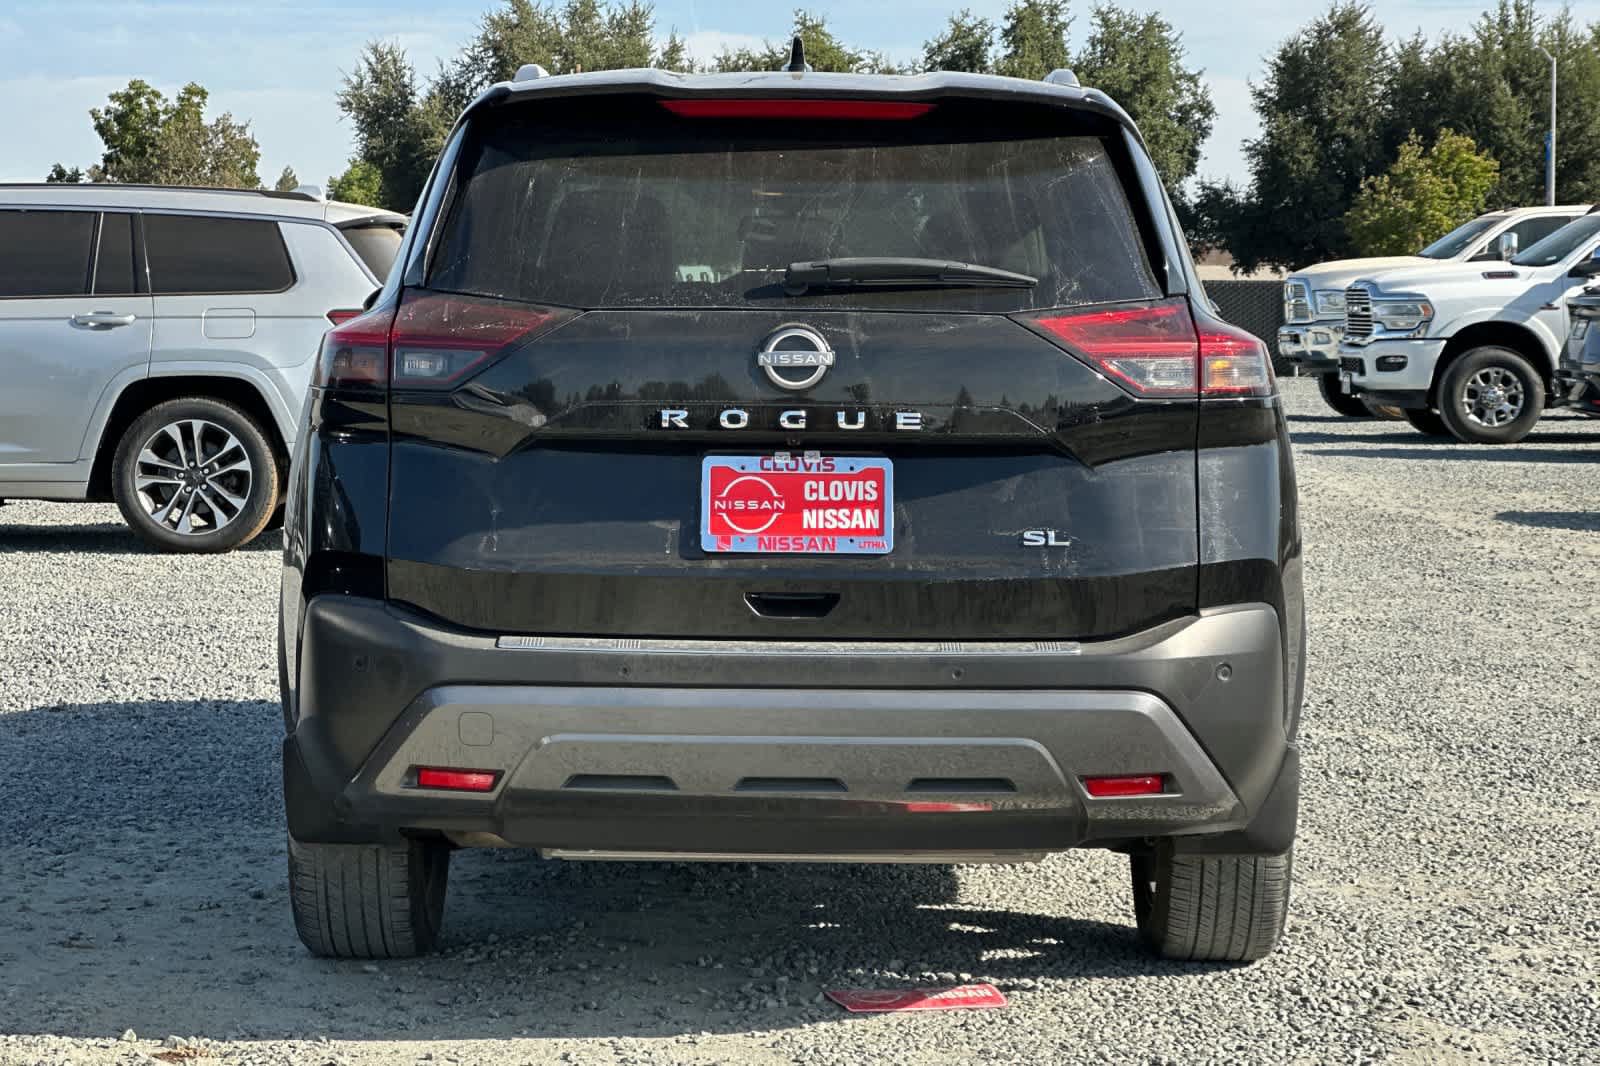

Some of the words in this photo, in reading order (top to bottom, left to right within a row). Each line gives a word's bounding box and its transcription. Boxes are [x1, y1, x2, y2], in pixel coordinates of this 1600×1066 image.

[759, 354, 831, 364] NISSAN
[661, 409, 921, 430] ROGUE
[759, 456, 836, 472] CLOVIS
[804, 480, 878, 501] CLOVIS
[714, 500, 785, 510] NISSAN
[802, 508, 879, 529] NISSAN
[757, 536, 836, 551] NISSAN
[858, 541, 888, 549] LITHIA
[1023, 530, 1070, 546] SL
